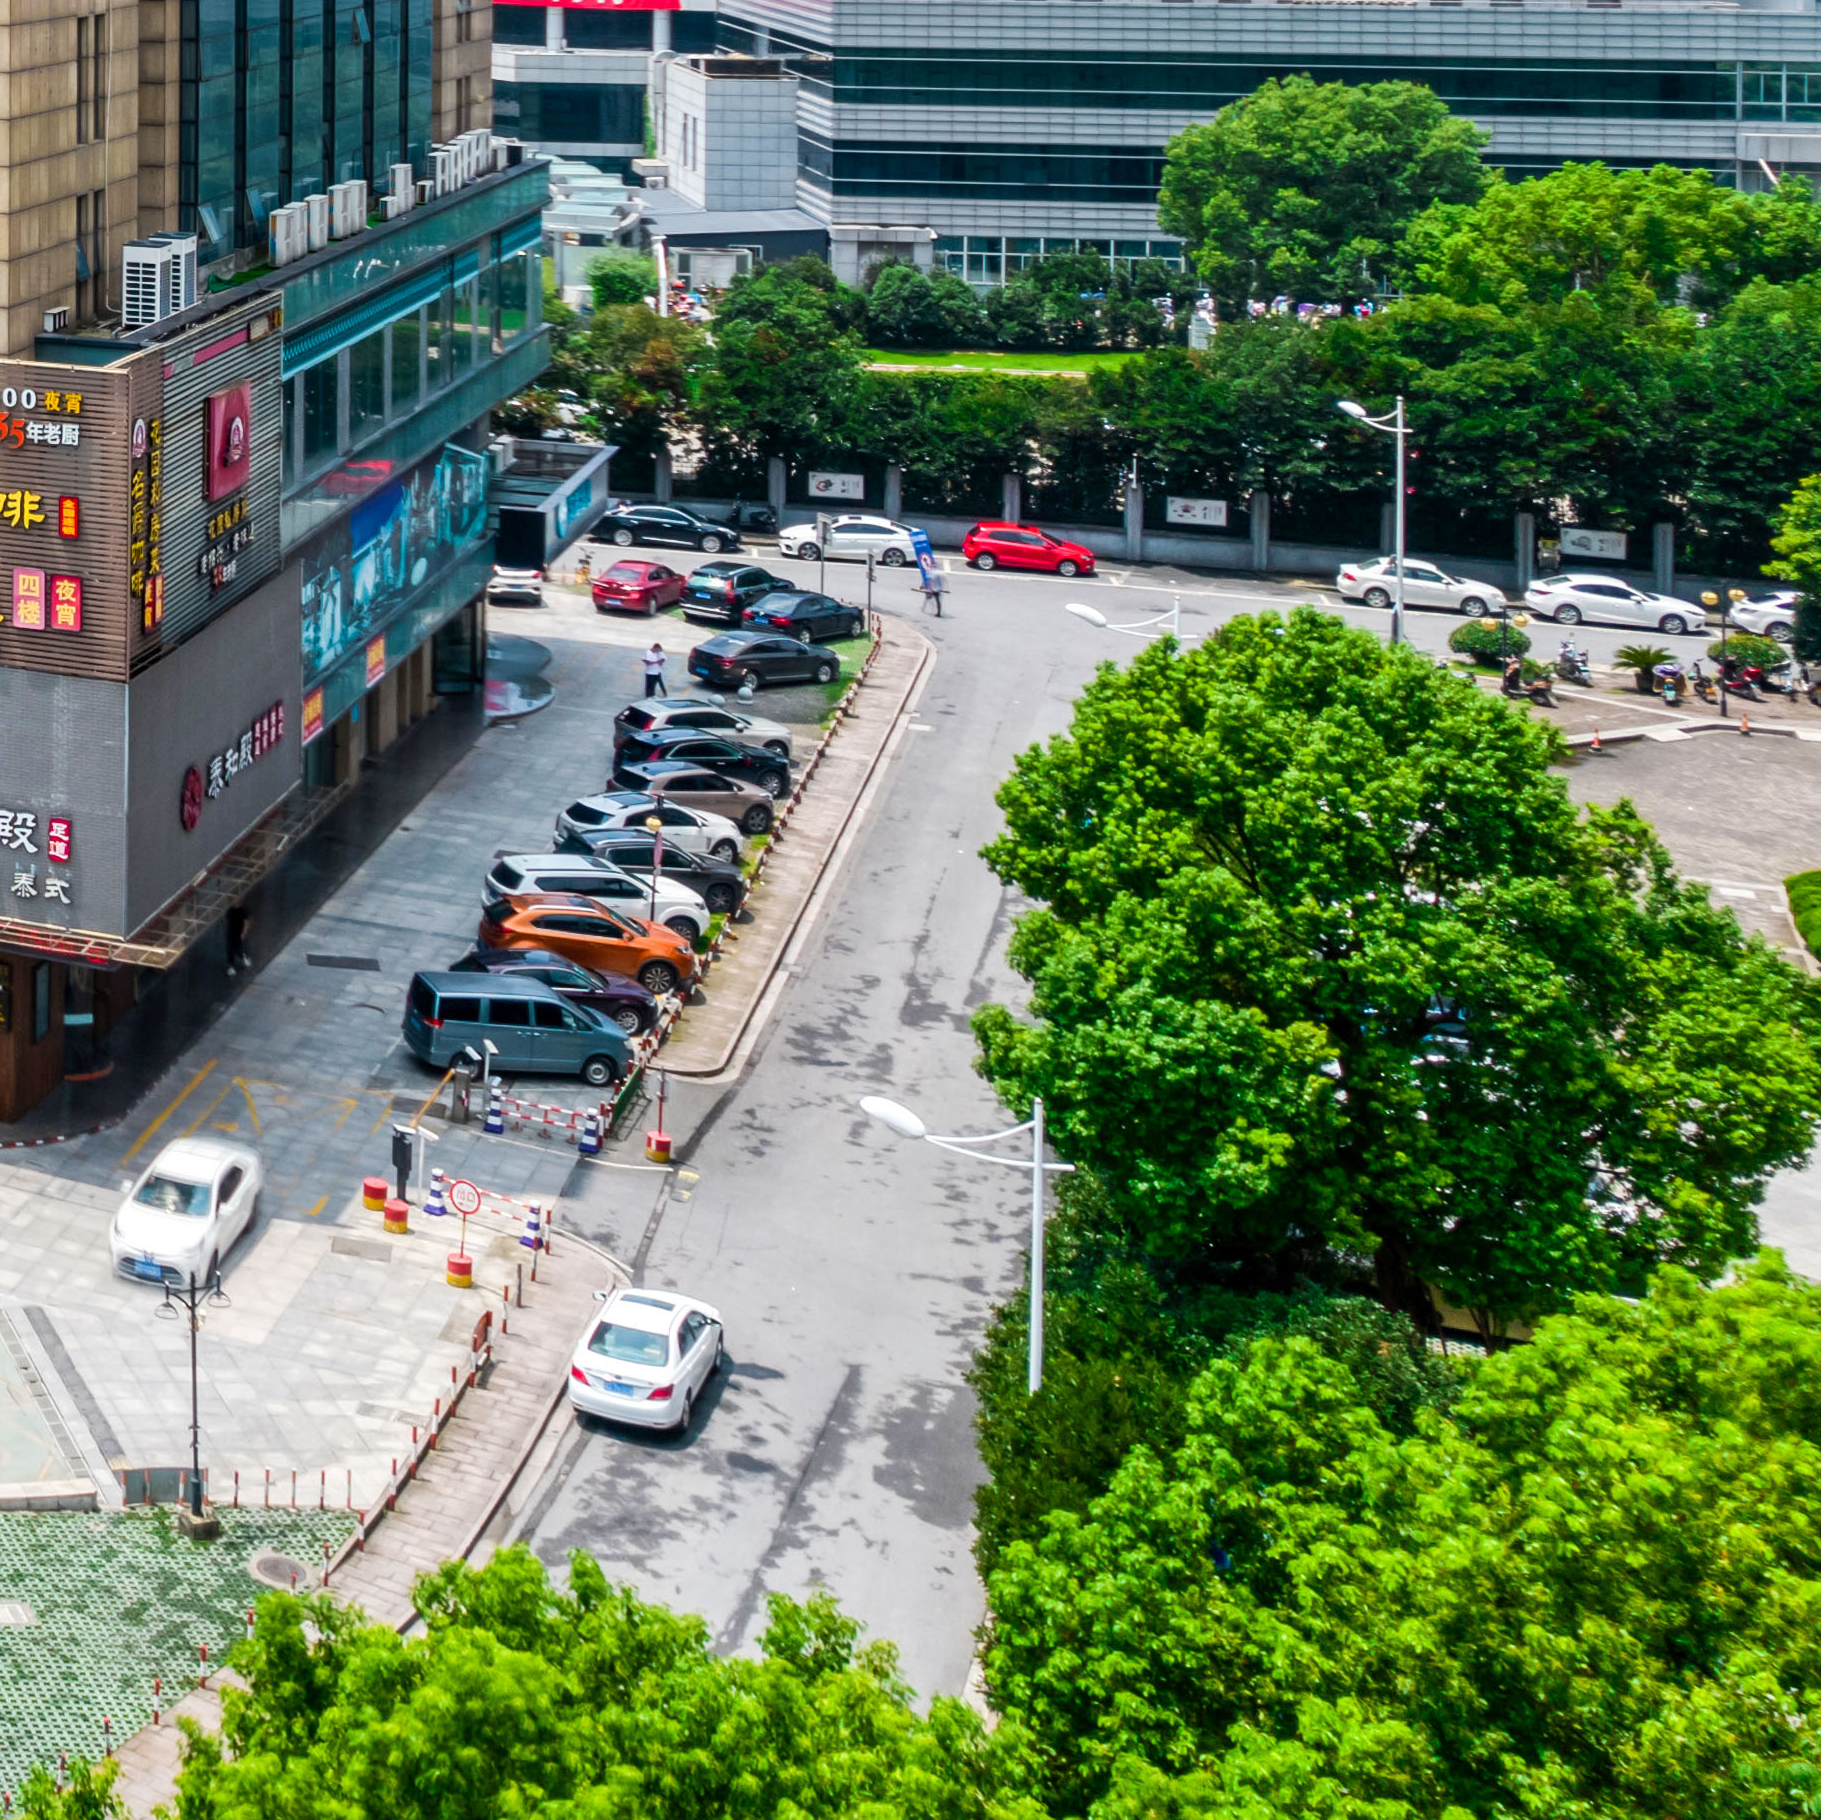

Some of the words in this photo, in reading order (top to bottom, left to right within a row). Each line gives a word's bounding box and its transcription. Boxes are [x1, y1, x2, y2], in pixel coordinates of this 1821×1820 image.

[17, 574, 42, 625] 四楼
[55, 578, 77, 627] 夜宵
[49, 822, 70, 860] 足道
[10, 872, 73, 905] 泰式
